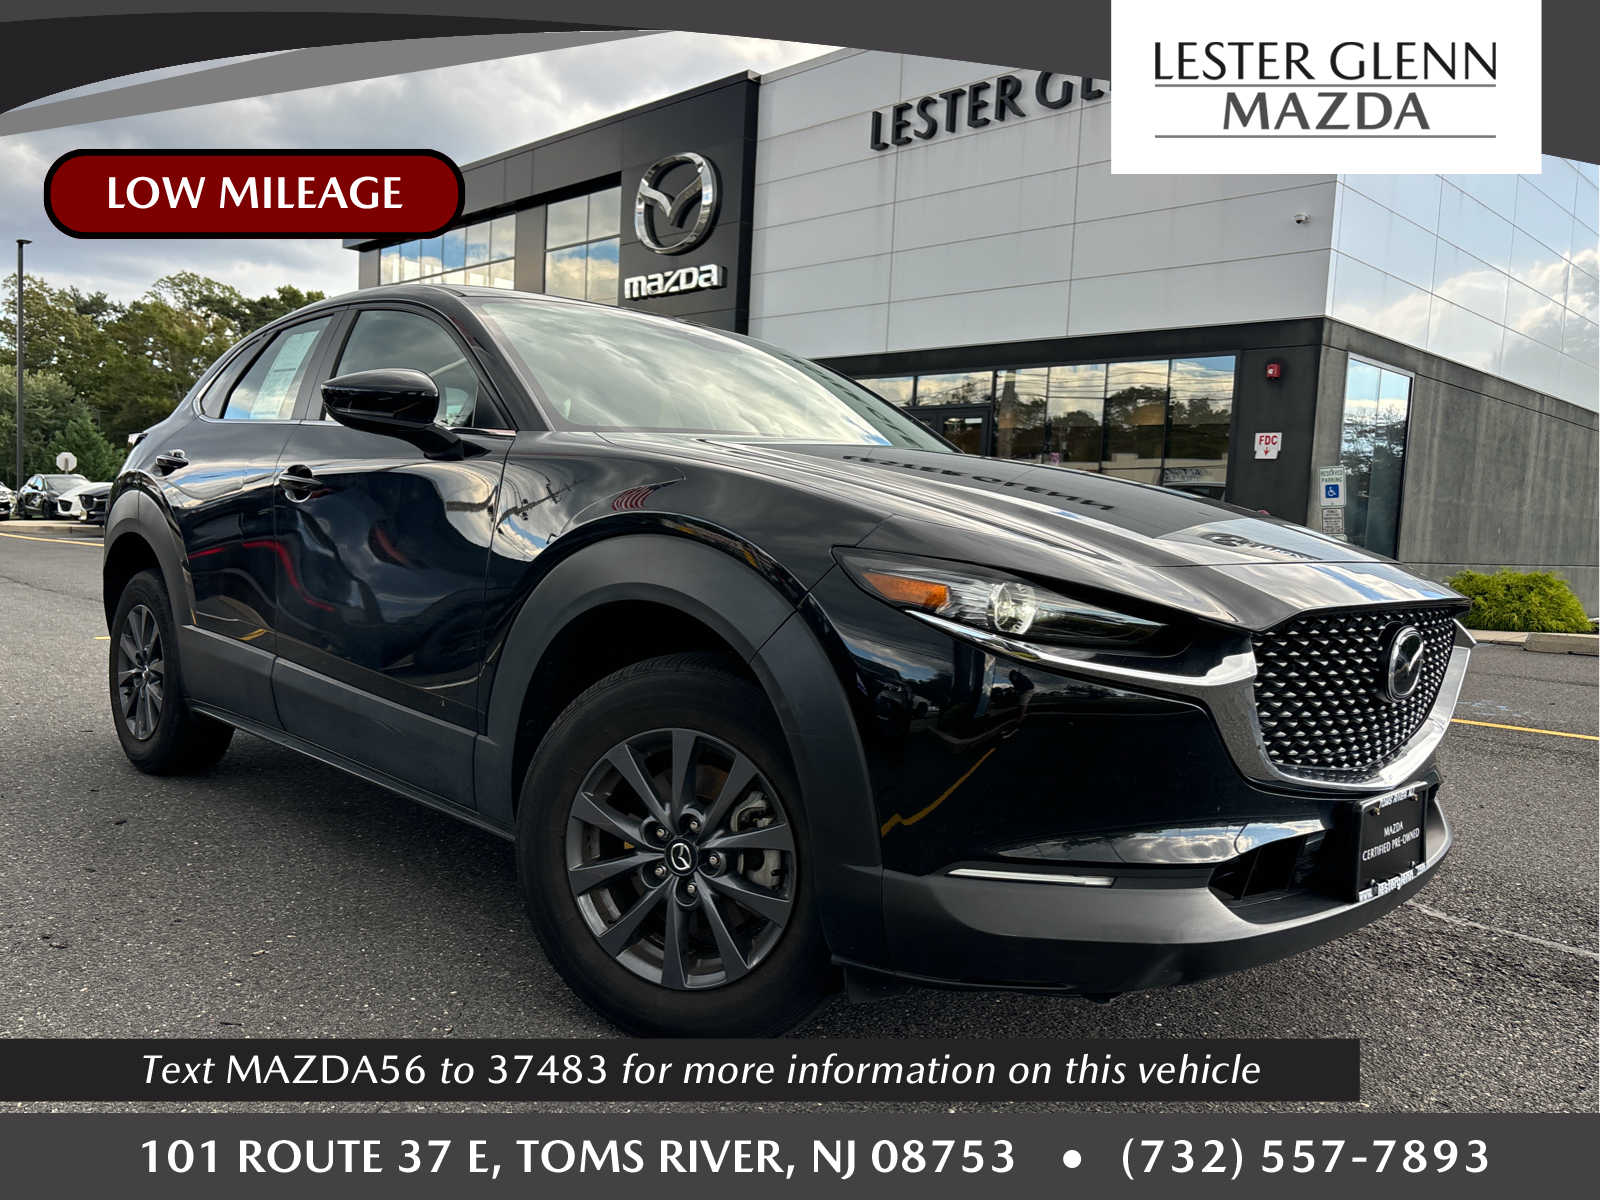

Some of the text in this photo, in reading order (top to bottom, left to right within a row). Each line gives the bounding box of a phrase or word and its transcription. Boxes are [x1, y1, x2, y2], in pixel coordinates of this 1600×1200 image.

[870, 71, 1110, 151] LESTER GL
[1258, 435, 1279, 447] FDC
[1383, 821, 1404, 837] MAZDA
[1362, 827, 1420, 862] CERTIFIED PRE-OWNED
